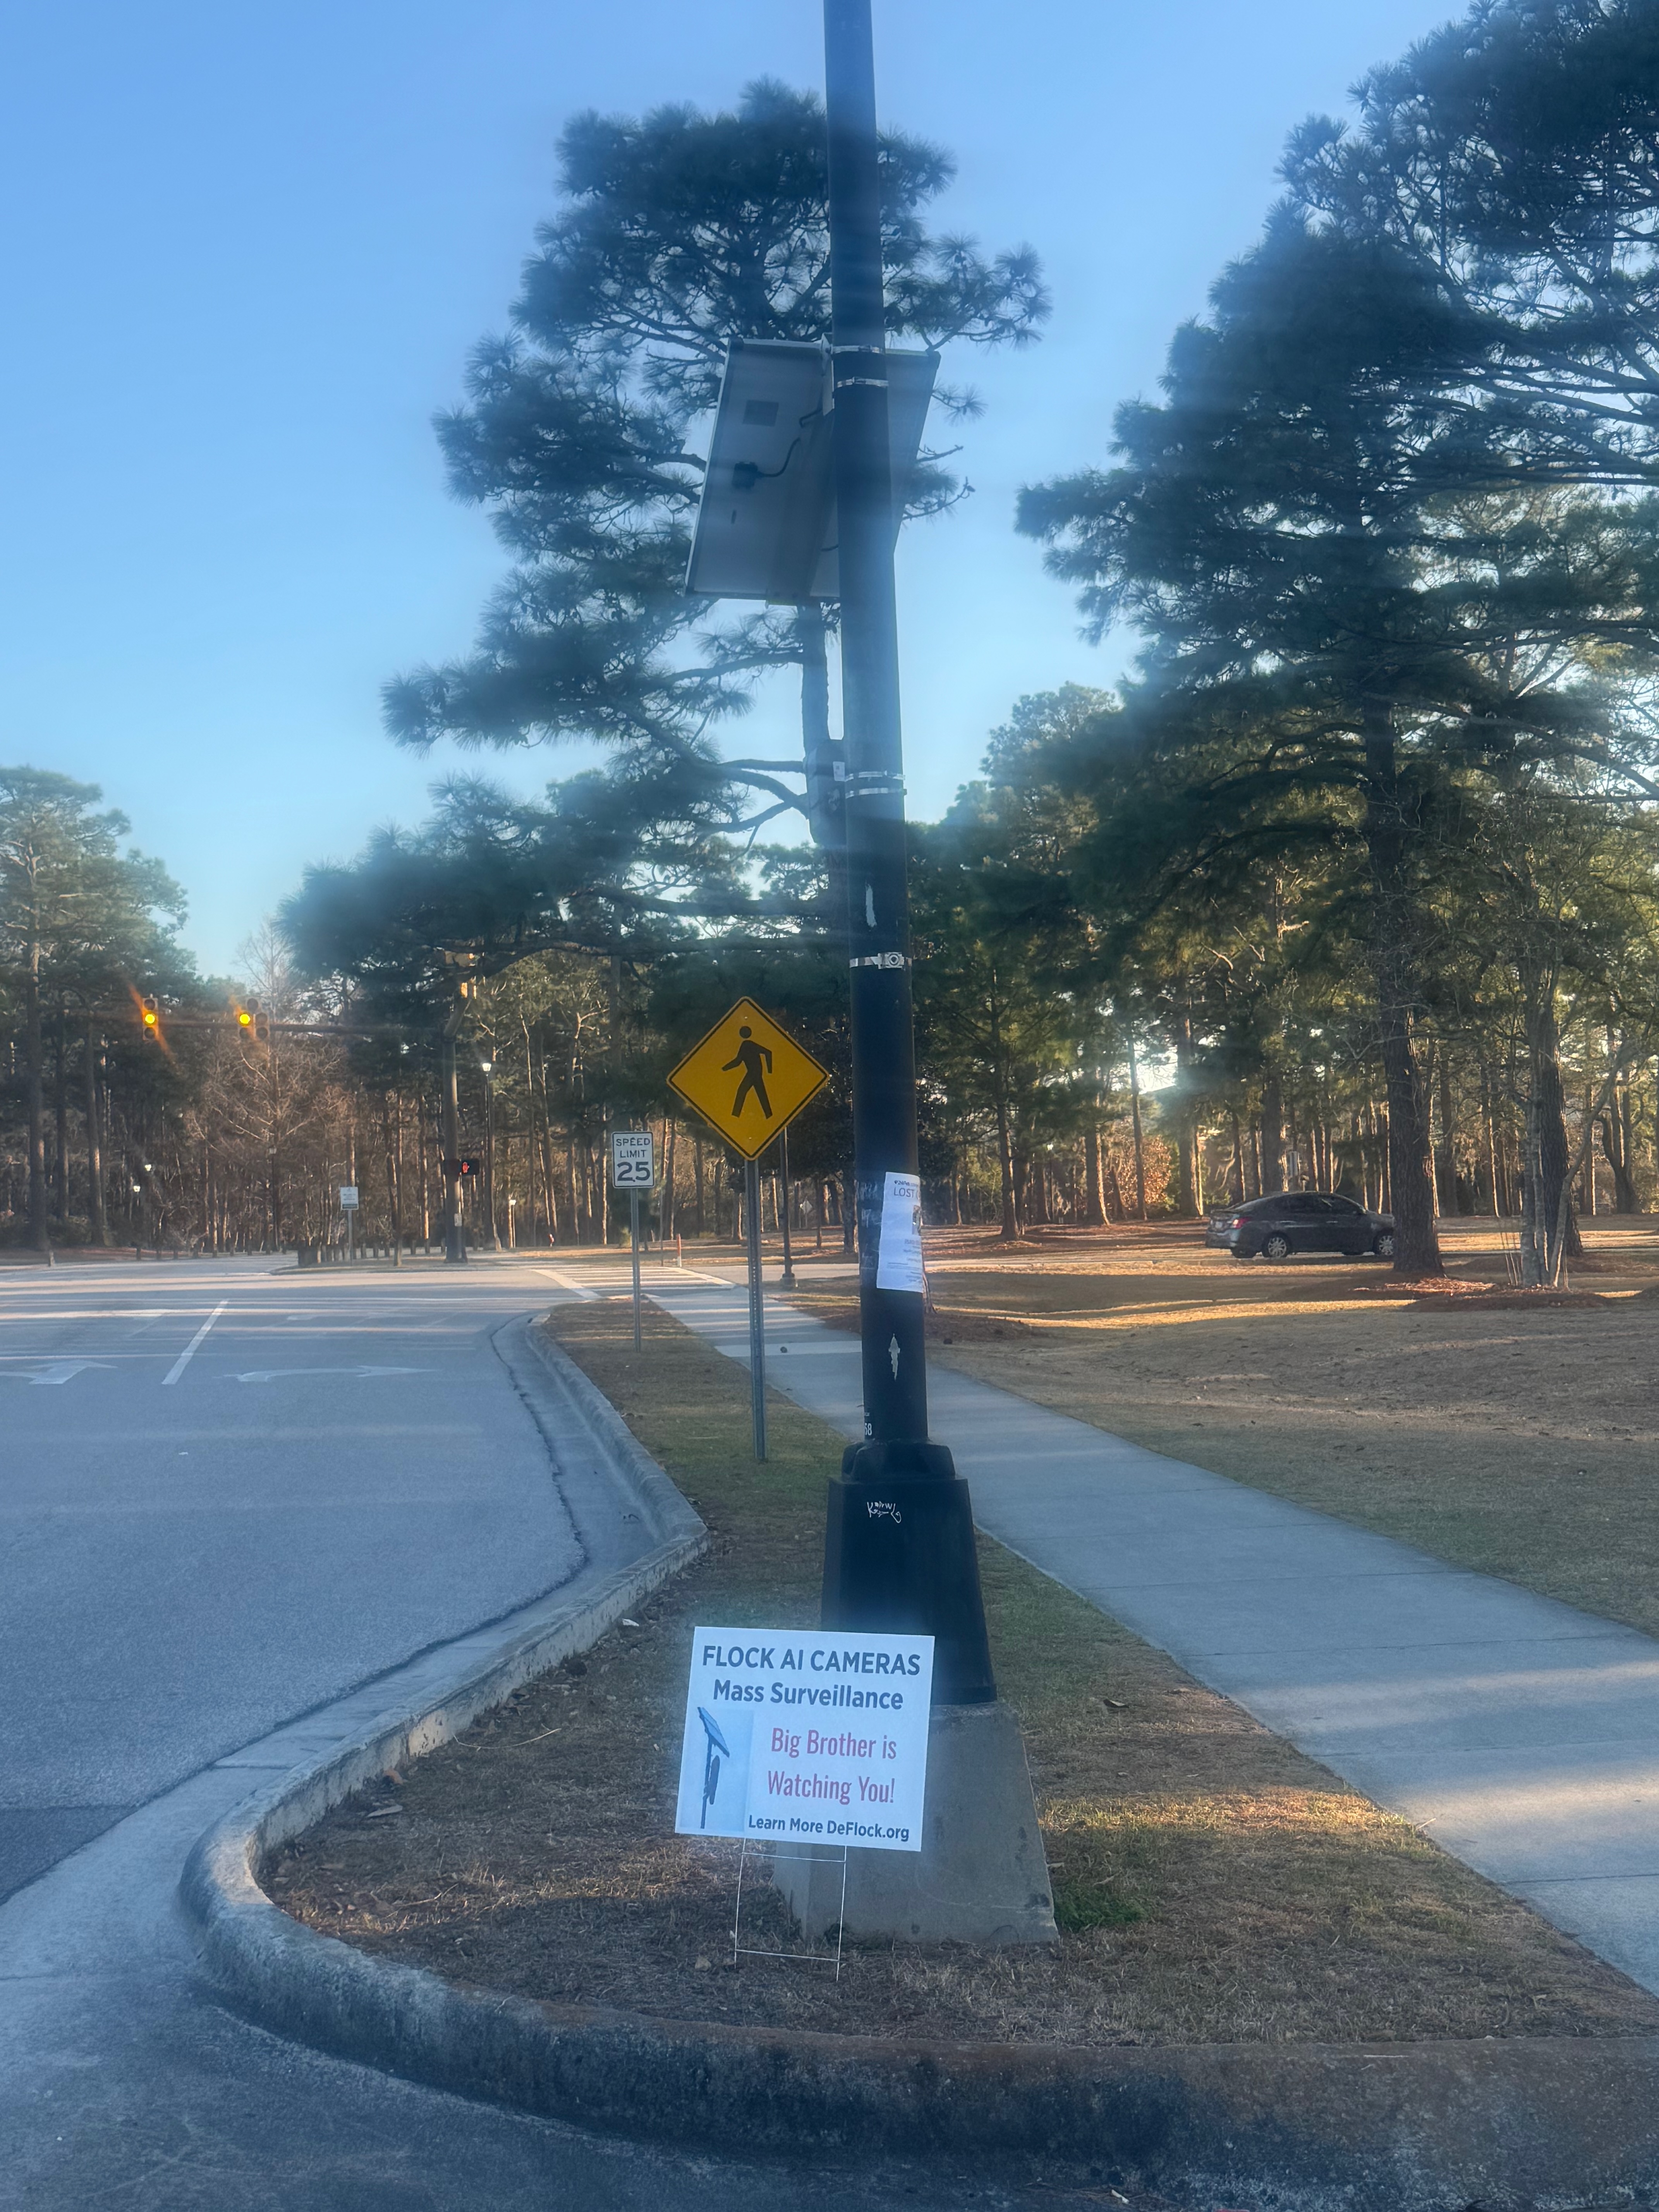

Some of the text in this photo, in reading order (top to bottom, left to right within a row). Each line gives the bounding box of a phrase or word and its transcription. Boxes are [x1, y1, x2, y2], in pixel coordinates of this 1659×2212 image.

[616, 1138, 650, 1146] SPEED
[620, 1150, 647, 1158] LIMIT
[617, 1161, 650, 1181] 25
[894, 1187, 915, 1198] LOST
[702, 1645, 921, 1676] FLOCK AI CAMERAS
[713, 1679, 903, 1710] Mass Surveillance
[771, 1728, 896, 1760] Big Brother is
[768, 1770, 895, 1805] Watching You!
[749, 1814, 909, 1843] Learn More DeFlock.org
